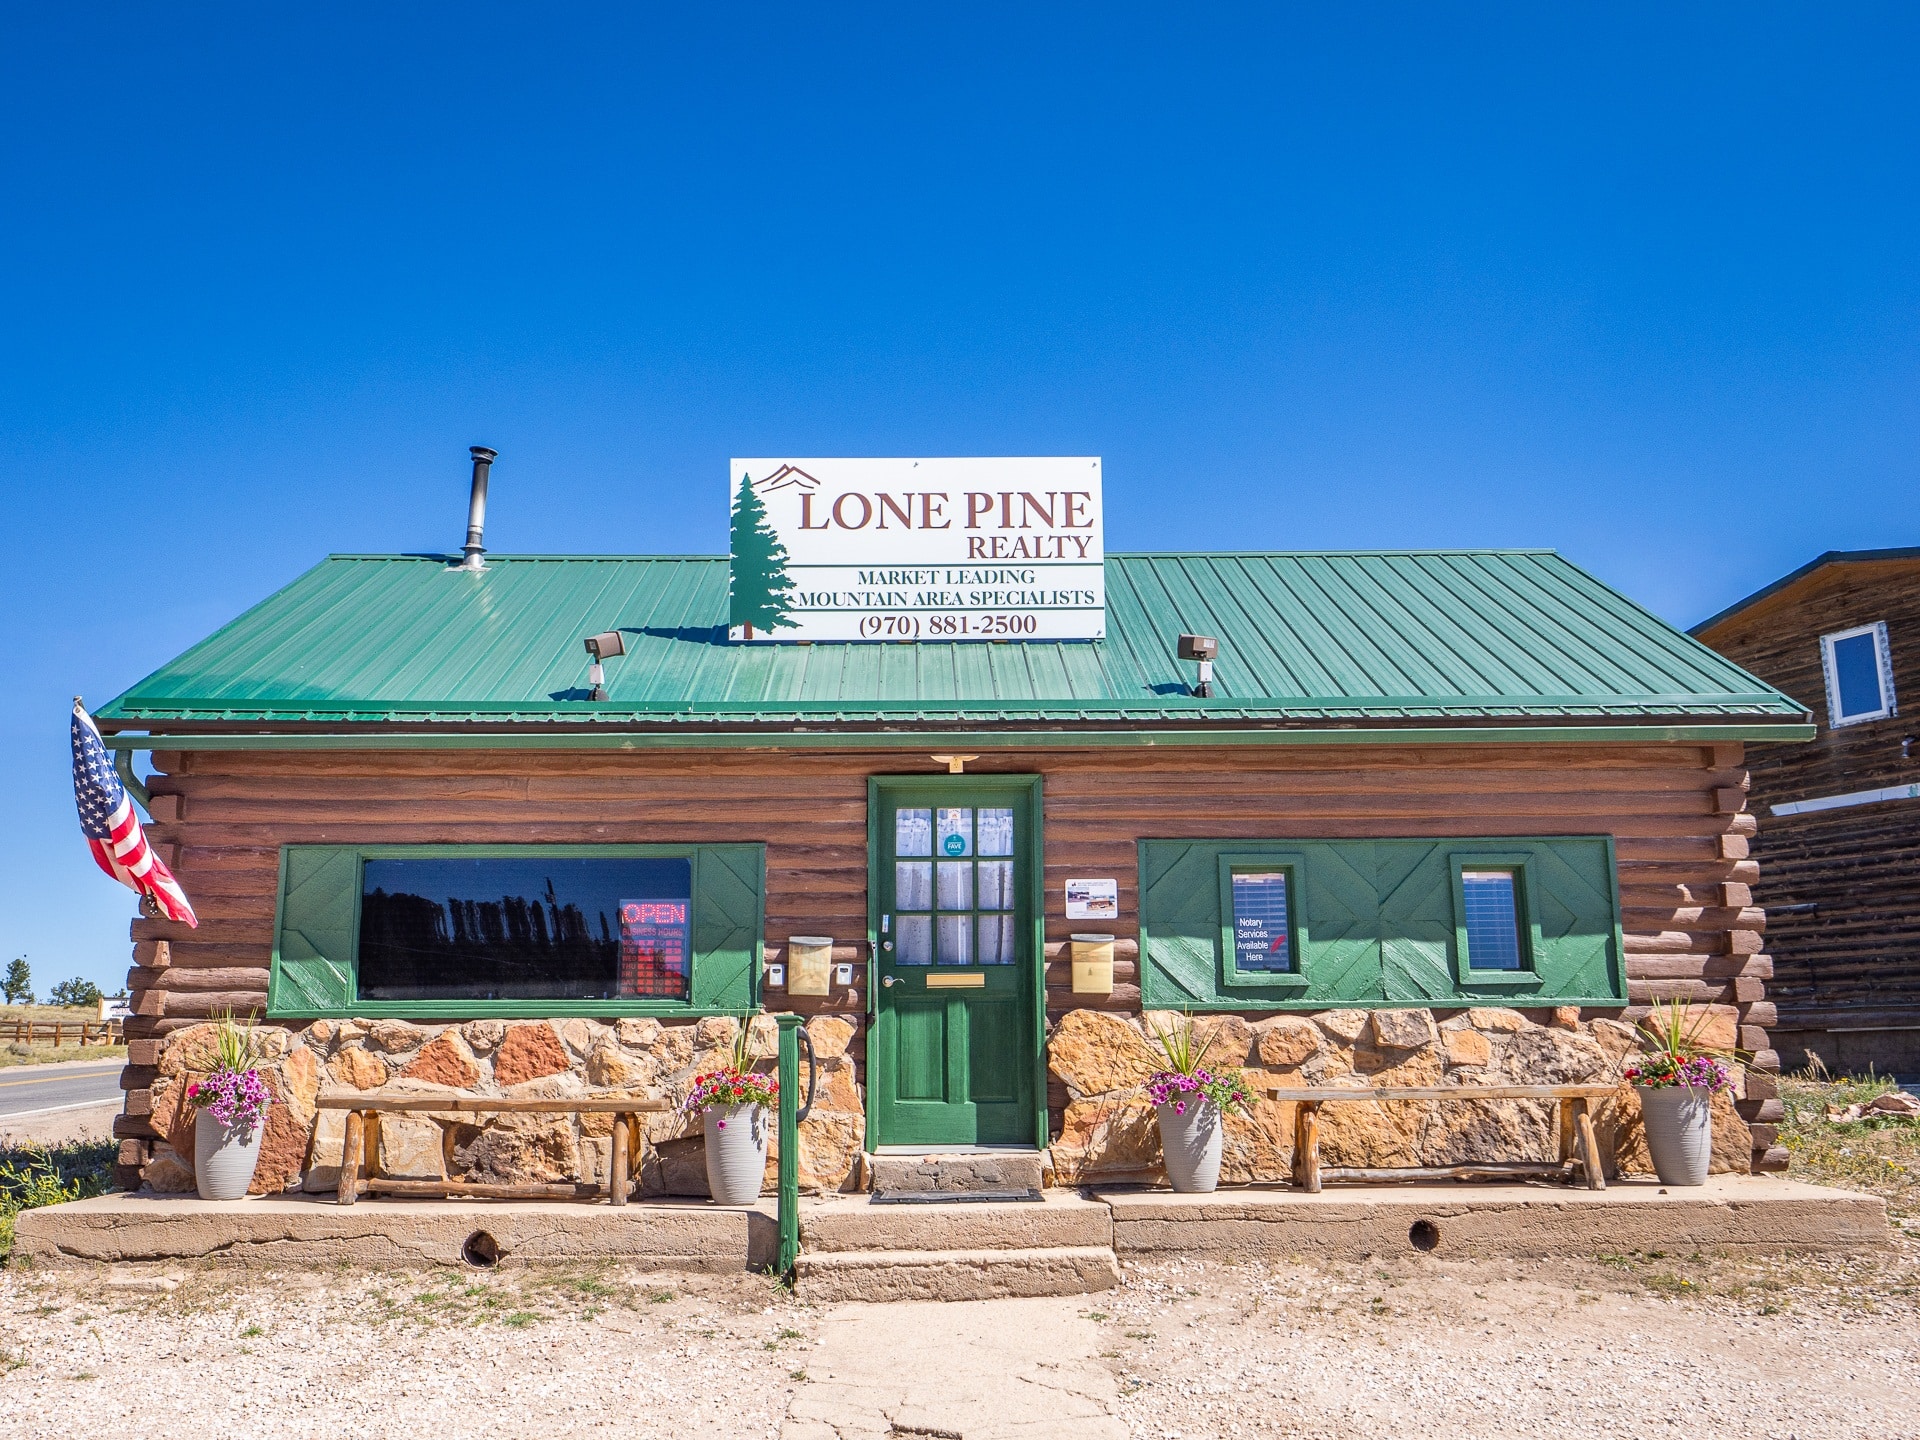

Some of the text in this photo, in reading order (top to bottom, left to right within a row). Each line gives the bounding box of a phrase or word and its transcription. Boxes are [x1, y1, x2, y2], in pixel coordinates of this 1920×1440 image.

[797, 491, 1095, 530] LONE PINE
[967, 535, 1094, 559] REALTY
[858, 569, 1036, 585] MARKET LEADING
[798, 590, 1095, 607] MOUNTAIN AREA SPECIALISTS
[859, 614, 1037, 638] (970) 881-2500
[623, 904, 685, 923] OPEN
[1239, 918, 1263, 928] Notary
[622, 928, 683, 936] BUSINESS HOURS
[1238, 929, 1268, 938] Services
[1237, 941, 1268, 950] Available
[1246, 952, 1263, 961] Here
